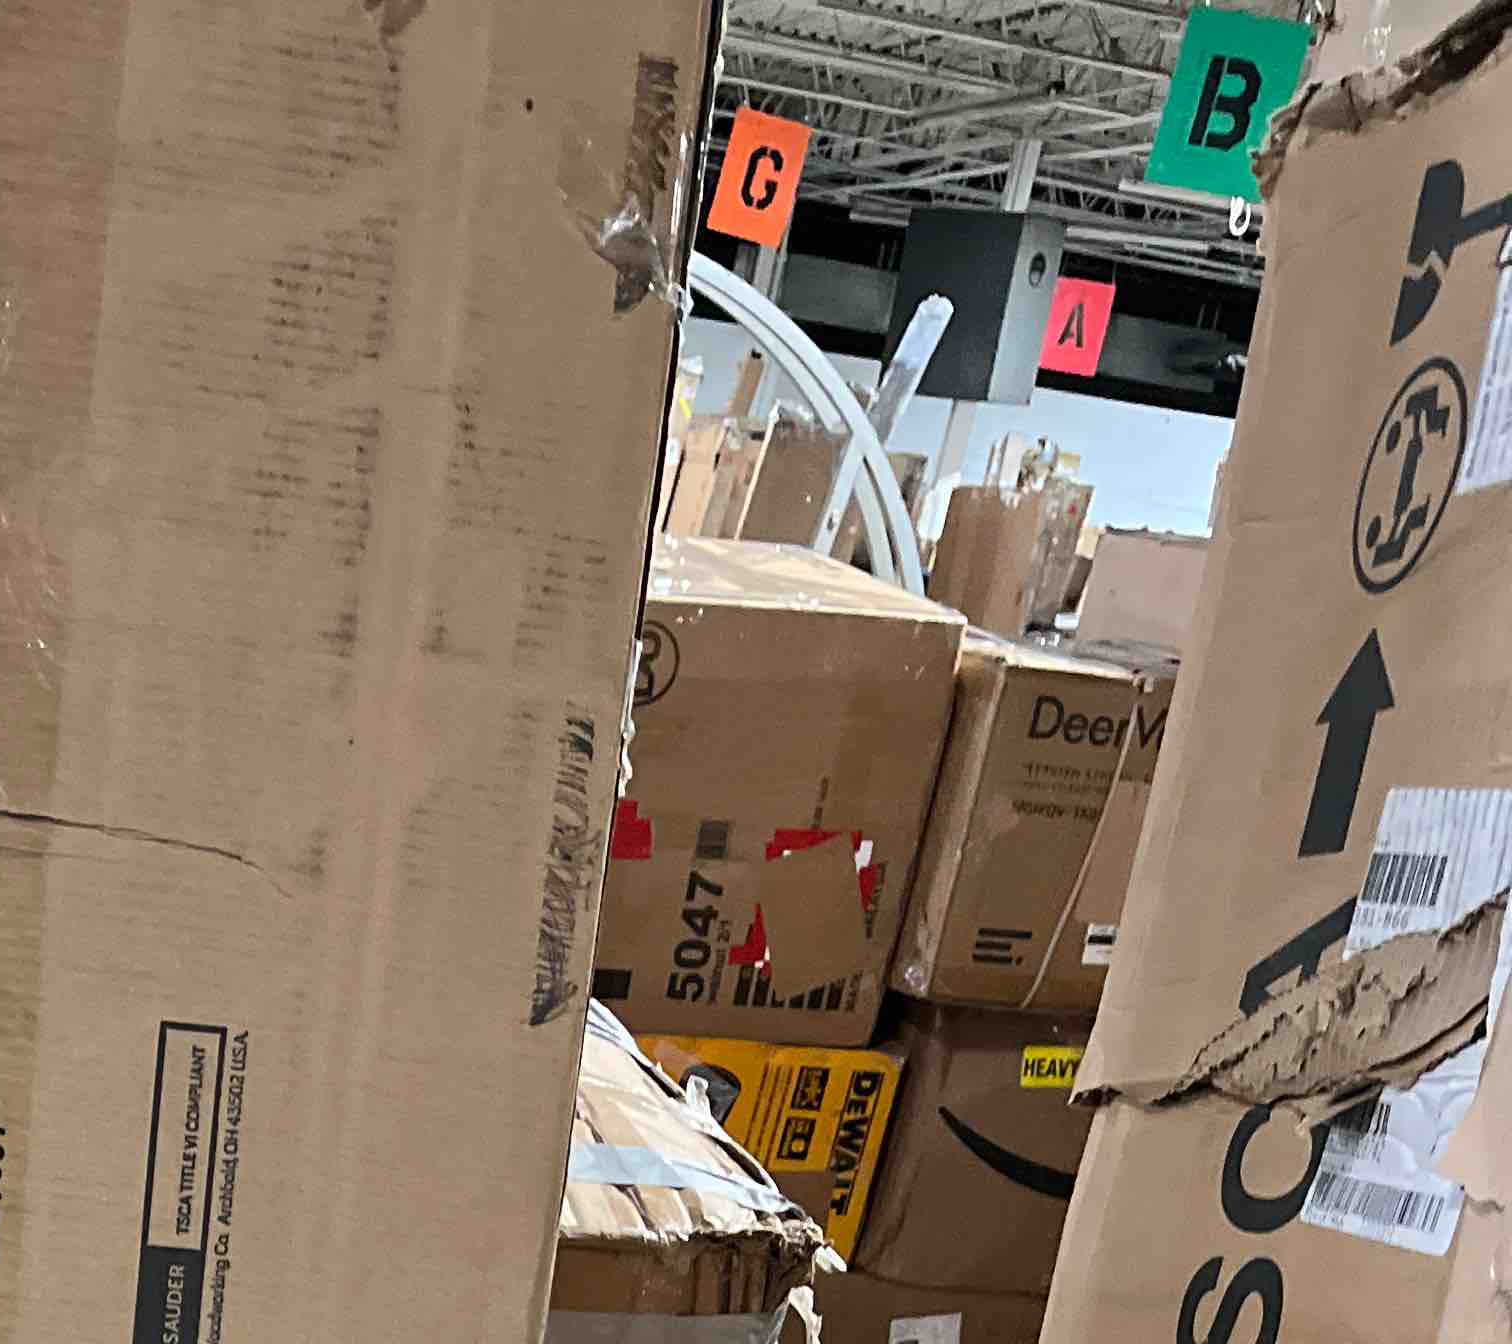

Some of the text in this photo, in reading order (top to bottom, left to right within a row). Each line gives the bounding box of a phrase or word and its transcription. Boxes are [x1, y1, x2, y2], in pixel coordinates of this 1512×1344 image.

[1188, 54, 1262, 151] B
[741, 144, 785, 212] G
[1058, 301, 1087, 349] A
[1028, 695, 1168, 748] DeerV
[667, 871, 725, 1002] 5047
[1024, 1058, 1081, 1078] HEAVY
[226, 1076, 245, 1127] 43502
[176, 1045, 207, 1236] TSCA TITLE VI COMPLIANT
[223, 1129, 239, 1156] OH
[163, 1263, 184, 1344] SAUDER
